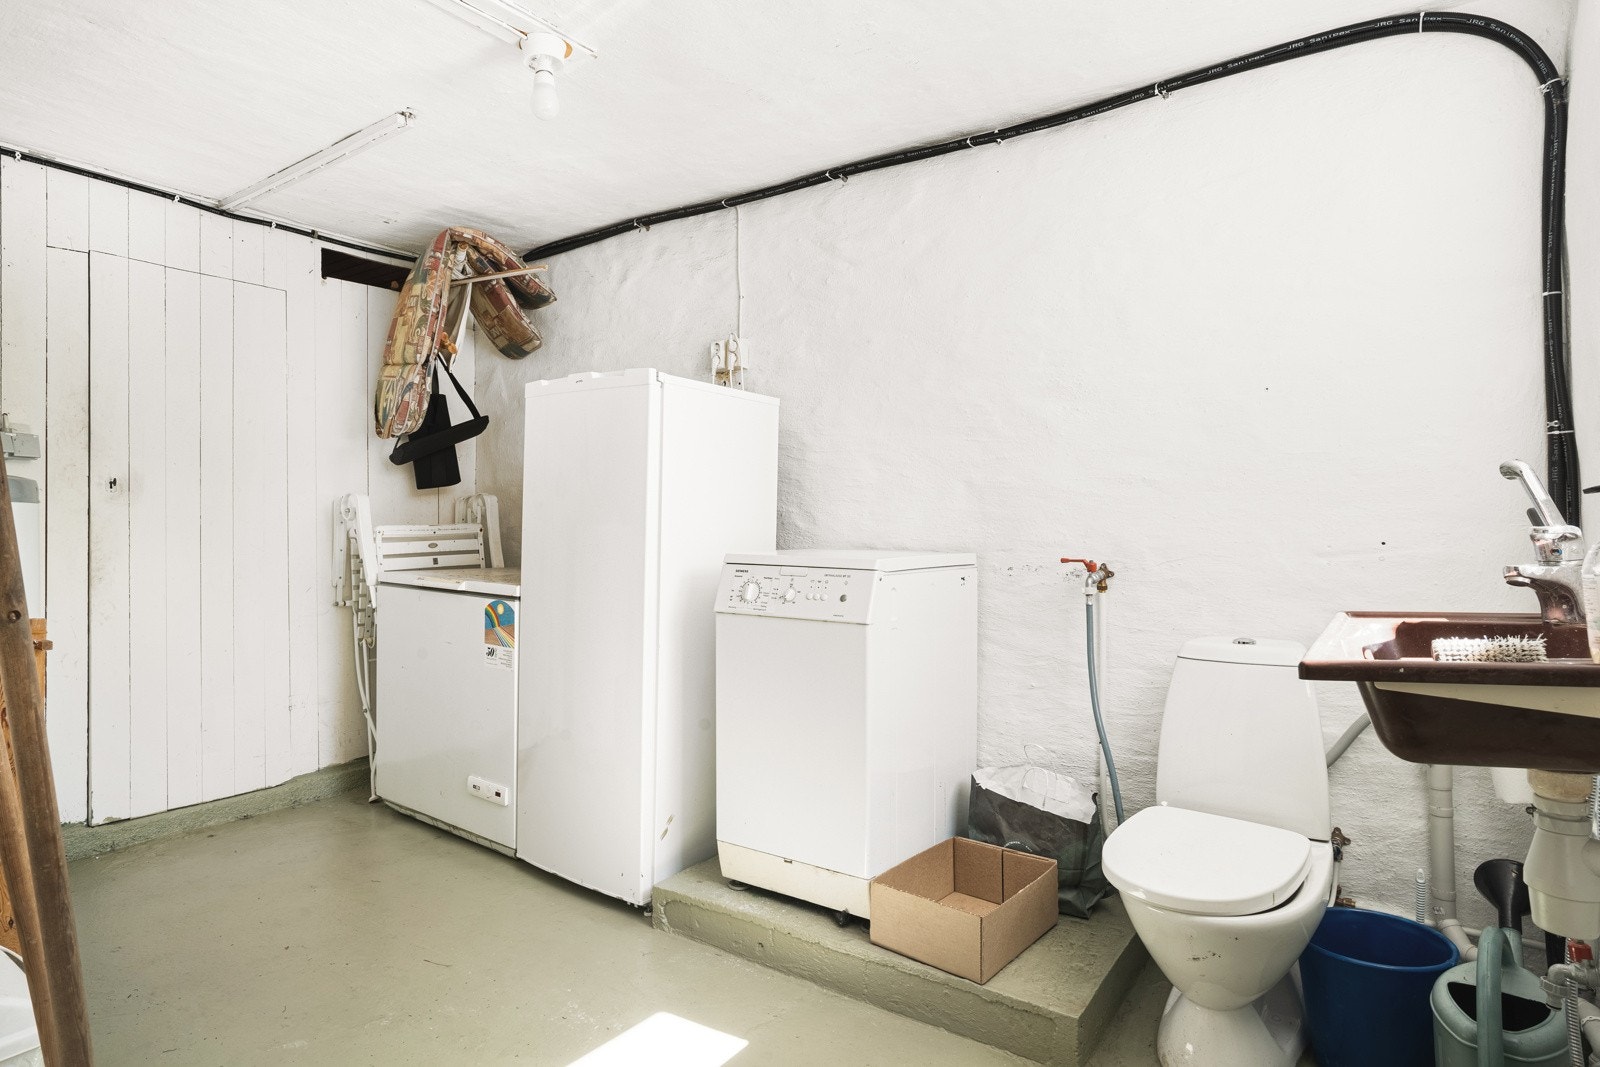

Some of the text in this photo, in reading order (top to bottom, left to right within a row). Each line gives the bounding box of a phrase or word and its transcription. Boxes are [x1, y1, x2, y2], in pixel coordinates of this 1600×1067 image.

[1374, 16, 1442, 28] JRG Sanpex
[1466, 18, 1525, 46] JRG Sanipex
[1287, 30, 1351, 50] JRG Sanipex
[1207, 54, 1265, 75] JRG Sanipex
[1536, 60, 1548, 75] JRG
[1131, 80, 1183, 100] JRG Snipex
